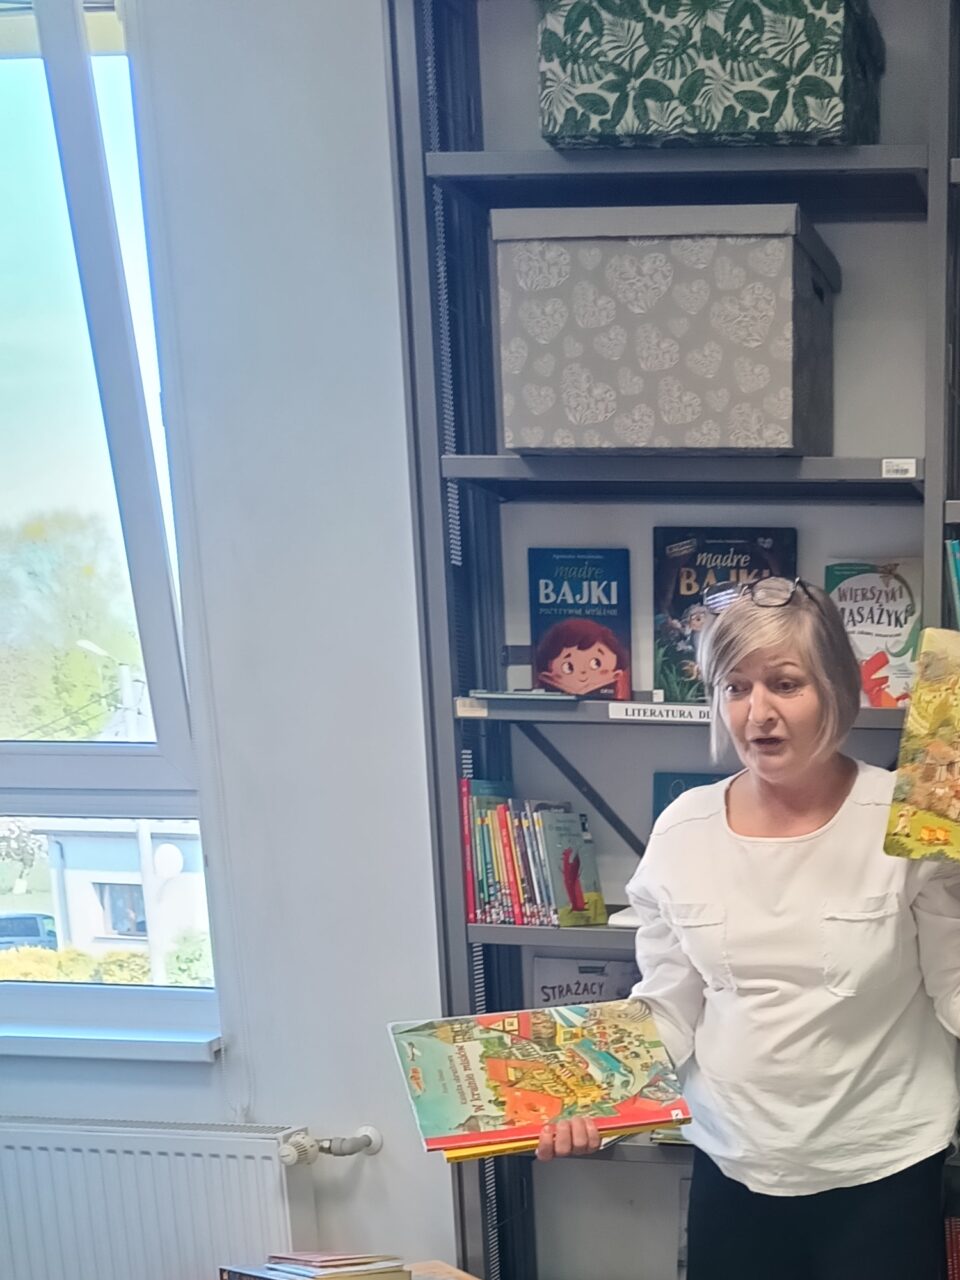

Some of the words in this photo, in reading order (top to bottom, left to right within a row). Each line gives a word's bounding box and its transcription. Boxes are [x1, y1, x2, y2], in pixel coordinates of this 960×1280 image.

[538, 578, 618, 605] BAJKI
[624, 707, 694, 719] LITERATURA
[698, 710, 712, 720] DL
[540, 980, 606, 1002] STRAŻACY
